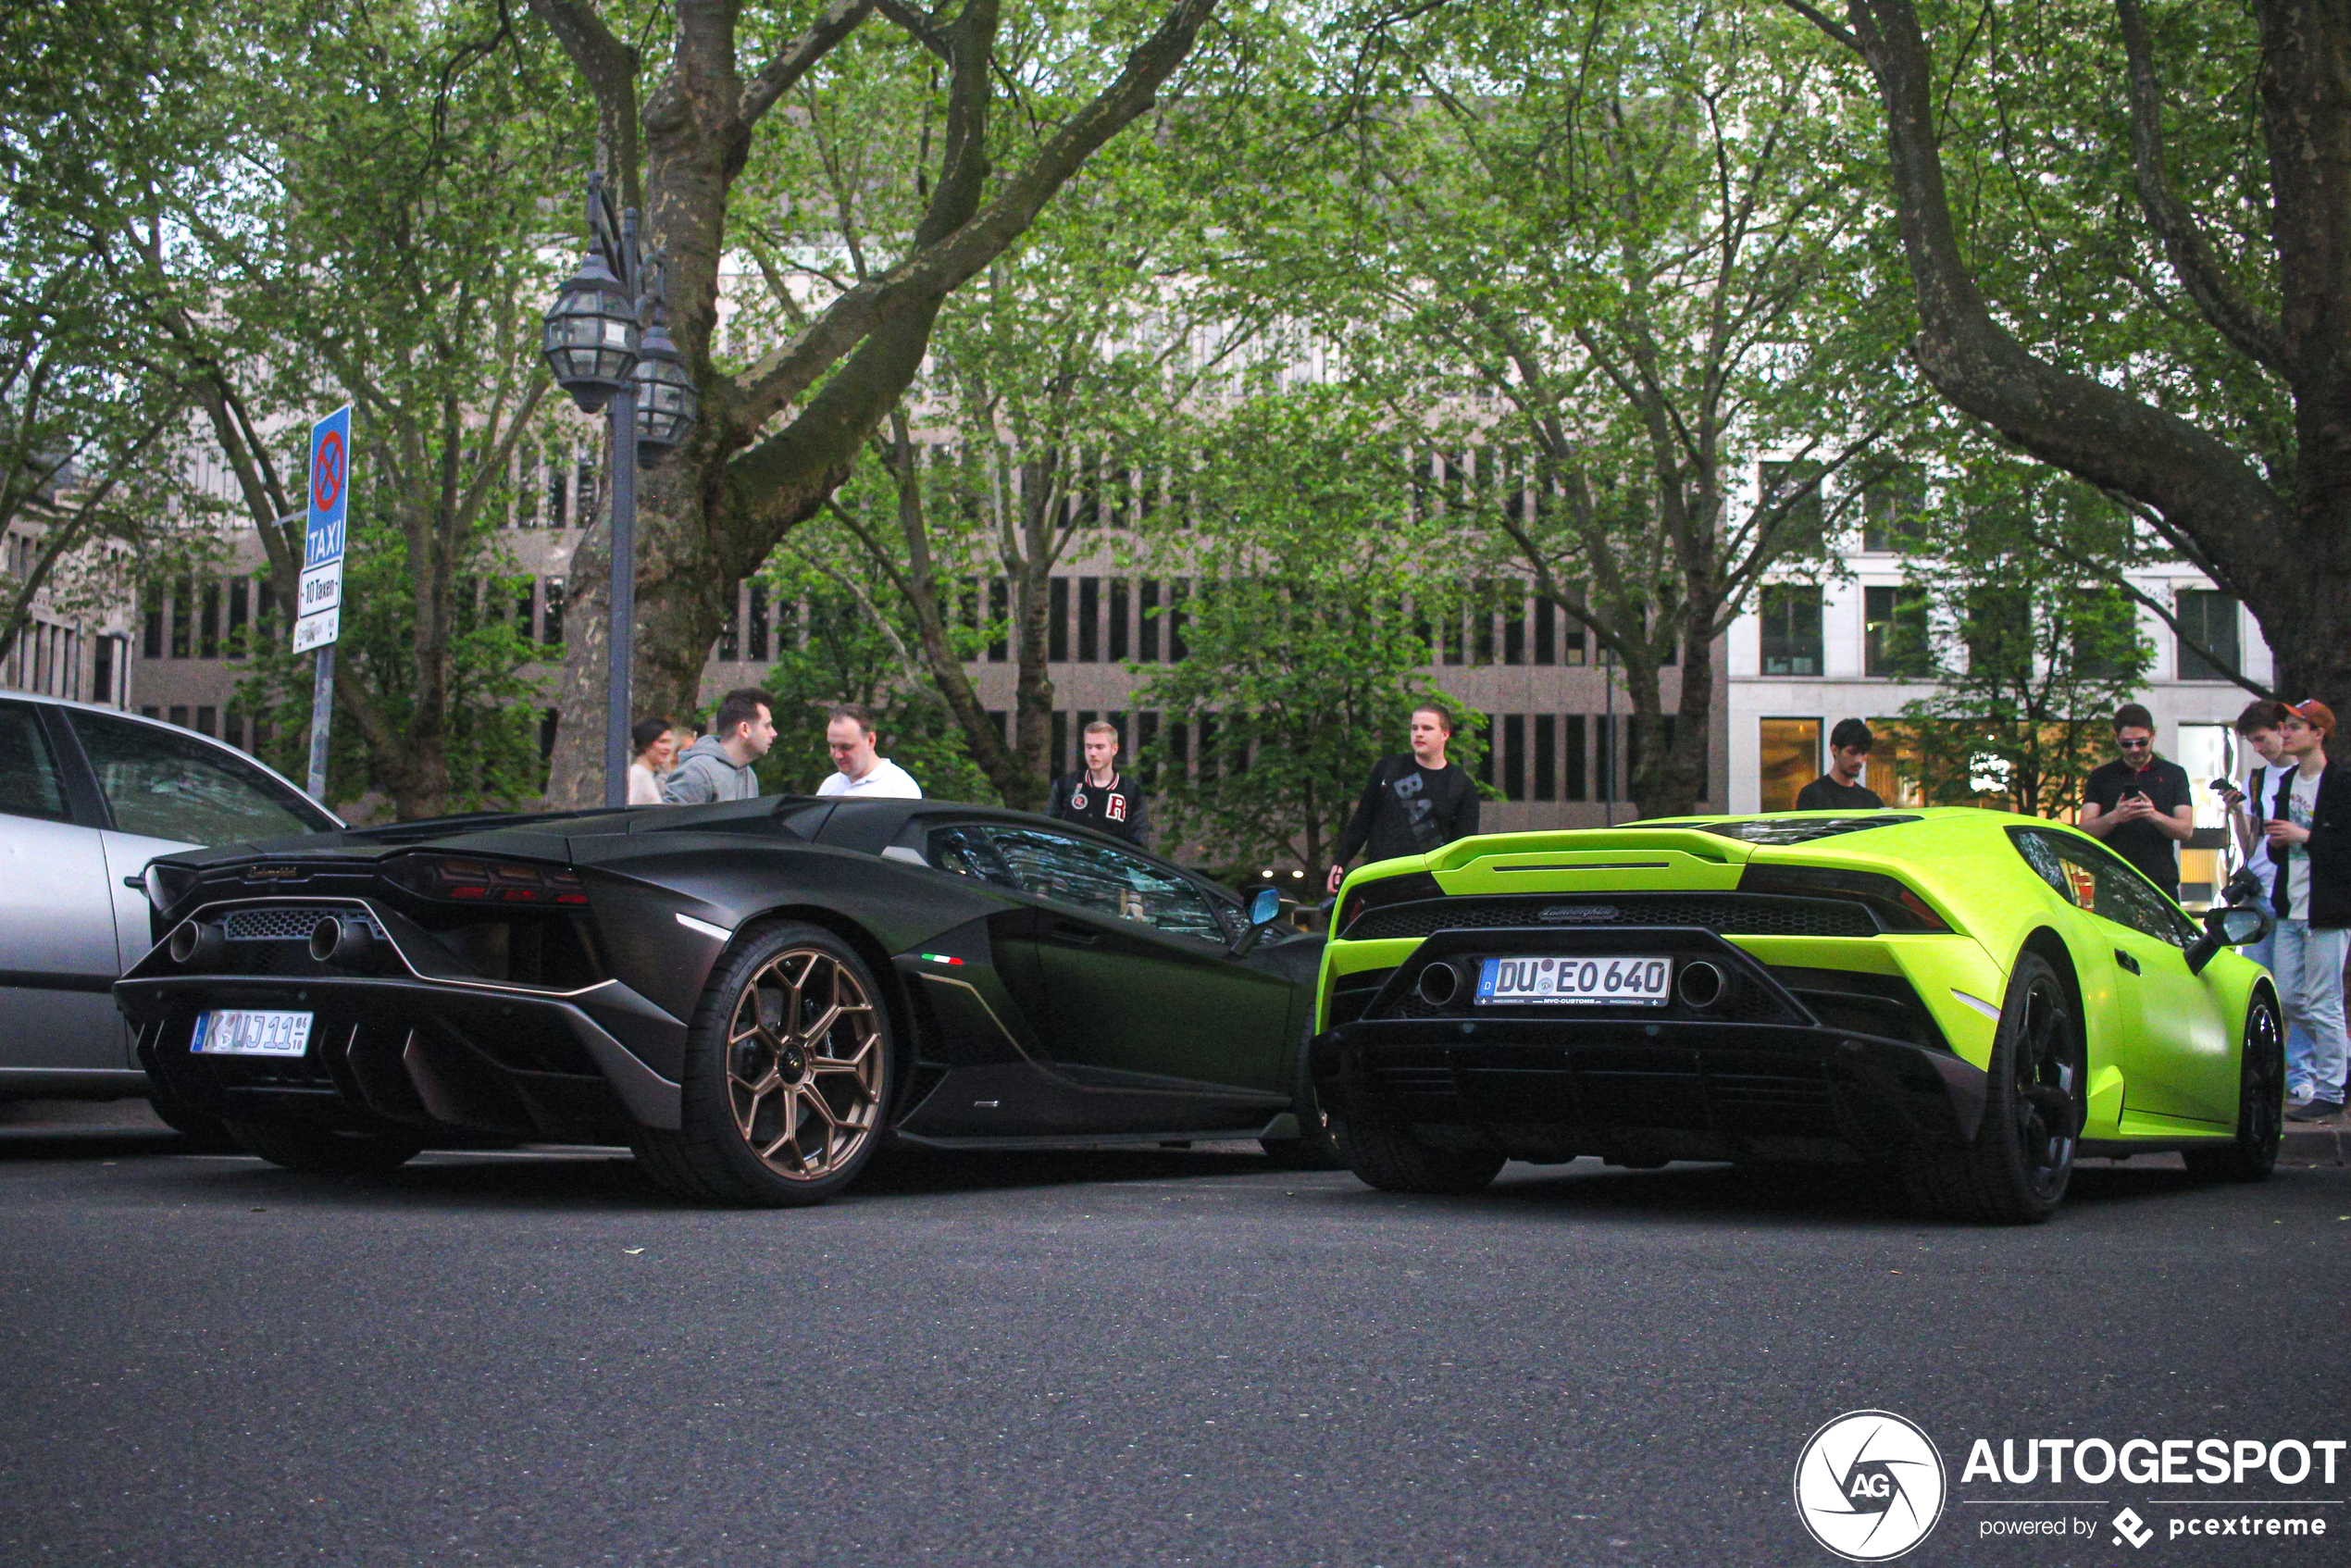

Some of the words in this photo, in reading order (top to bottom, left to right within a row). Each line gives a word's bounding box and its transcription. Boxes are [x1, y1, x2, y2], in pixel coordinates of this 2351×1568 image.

[309, 519, 342, 563] TAXI
[306, 580, 315, 604] 10
[316, 579, 335, 601] Taxen
[1105, 792, 1126, 822] R
[1497, 961, 1538, 992] DU
[1603, 961, 1665, 993] 640
